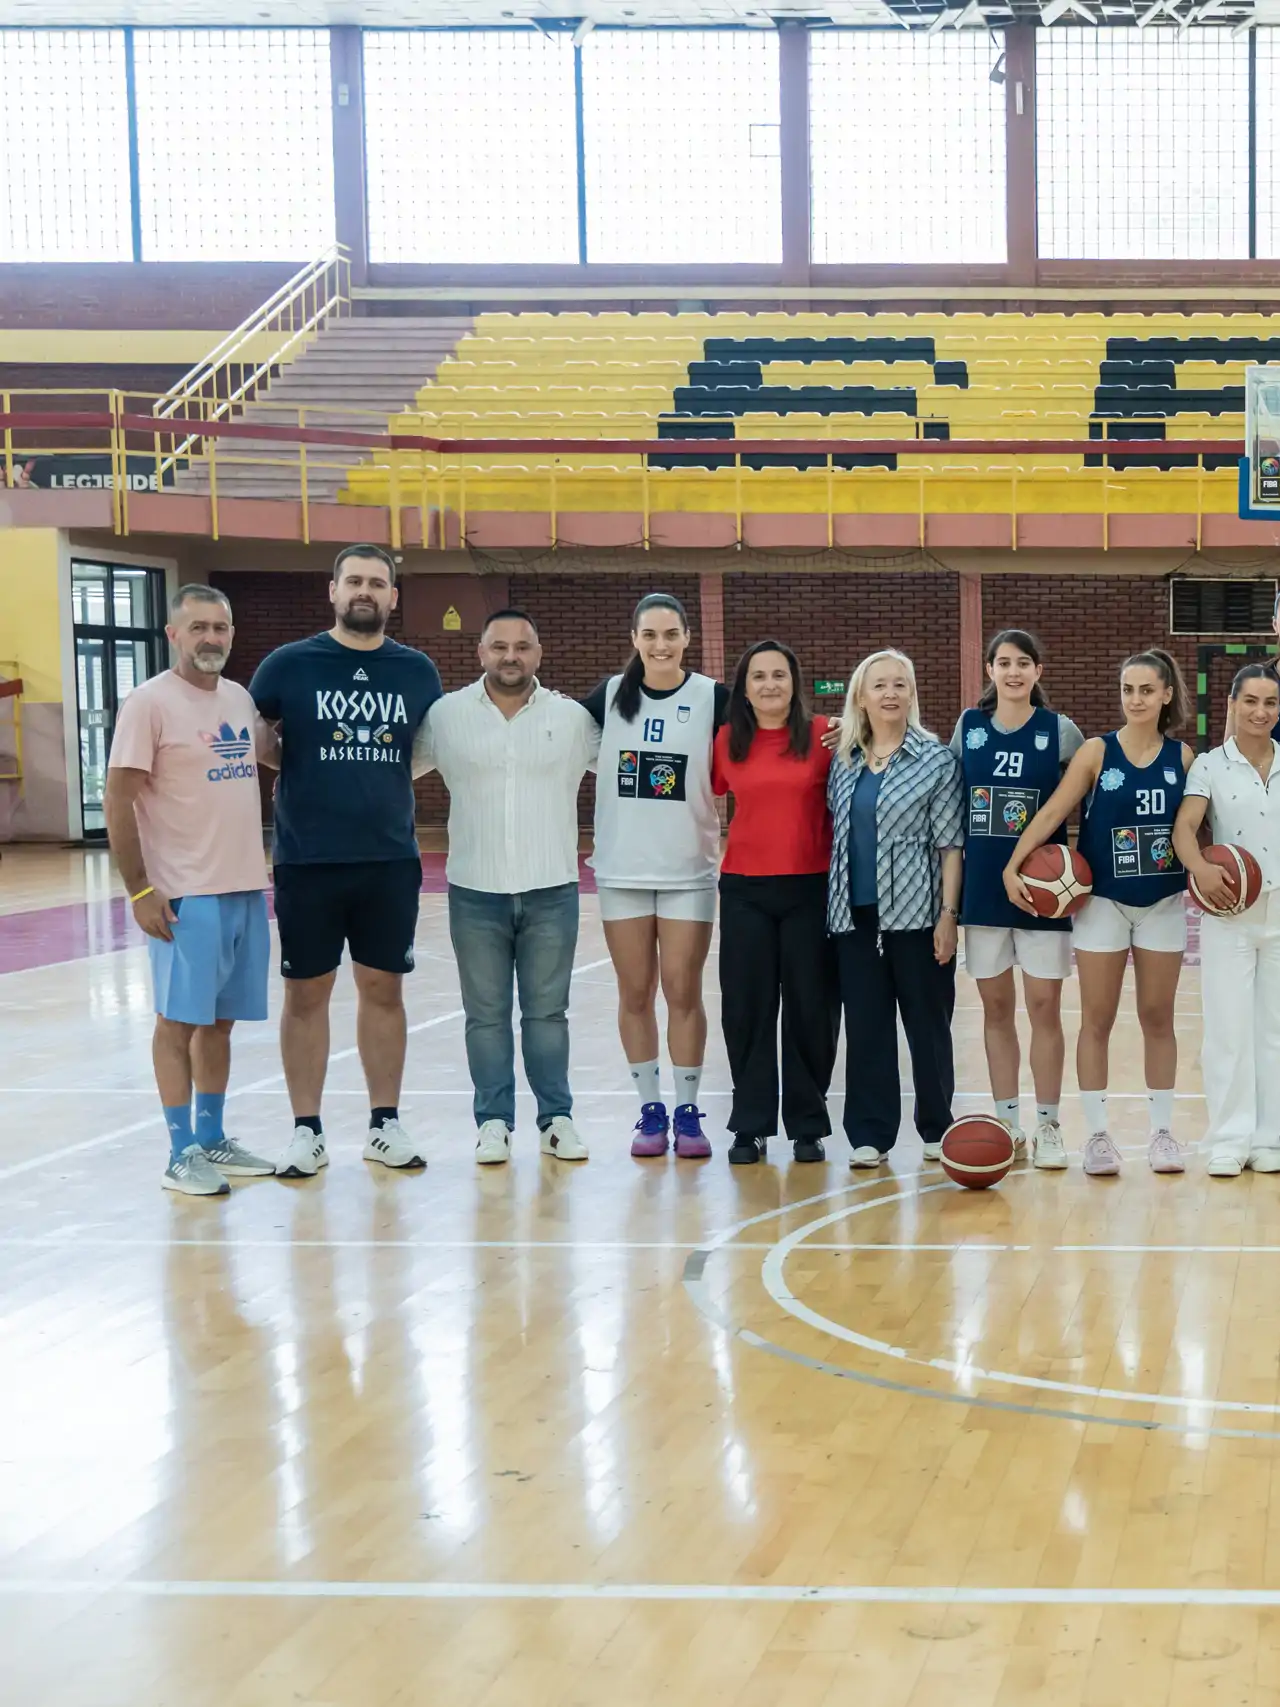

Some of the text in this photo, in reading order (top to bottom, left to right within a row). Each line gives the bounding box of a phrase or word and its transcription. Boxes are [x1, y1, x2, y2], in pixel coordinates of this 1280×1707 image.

[316, 690, 408, 724] KOSOVA
[643, 717, 665, 743] 19
[320, 746, 401, 763] BASKETBALL
[992, 751, 1024, 778] 29
[1135, 788, 1166, 815] 30
[972, 814, 987, 823] FIBA
[1118, 854, 1136, 865] FIBA
